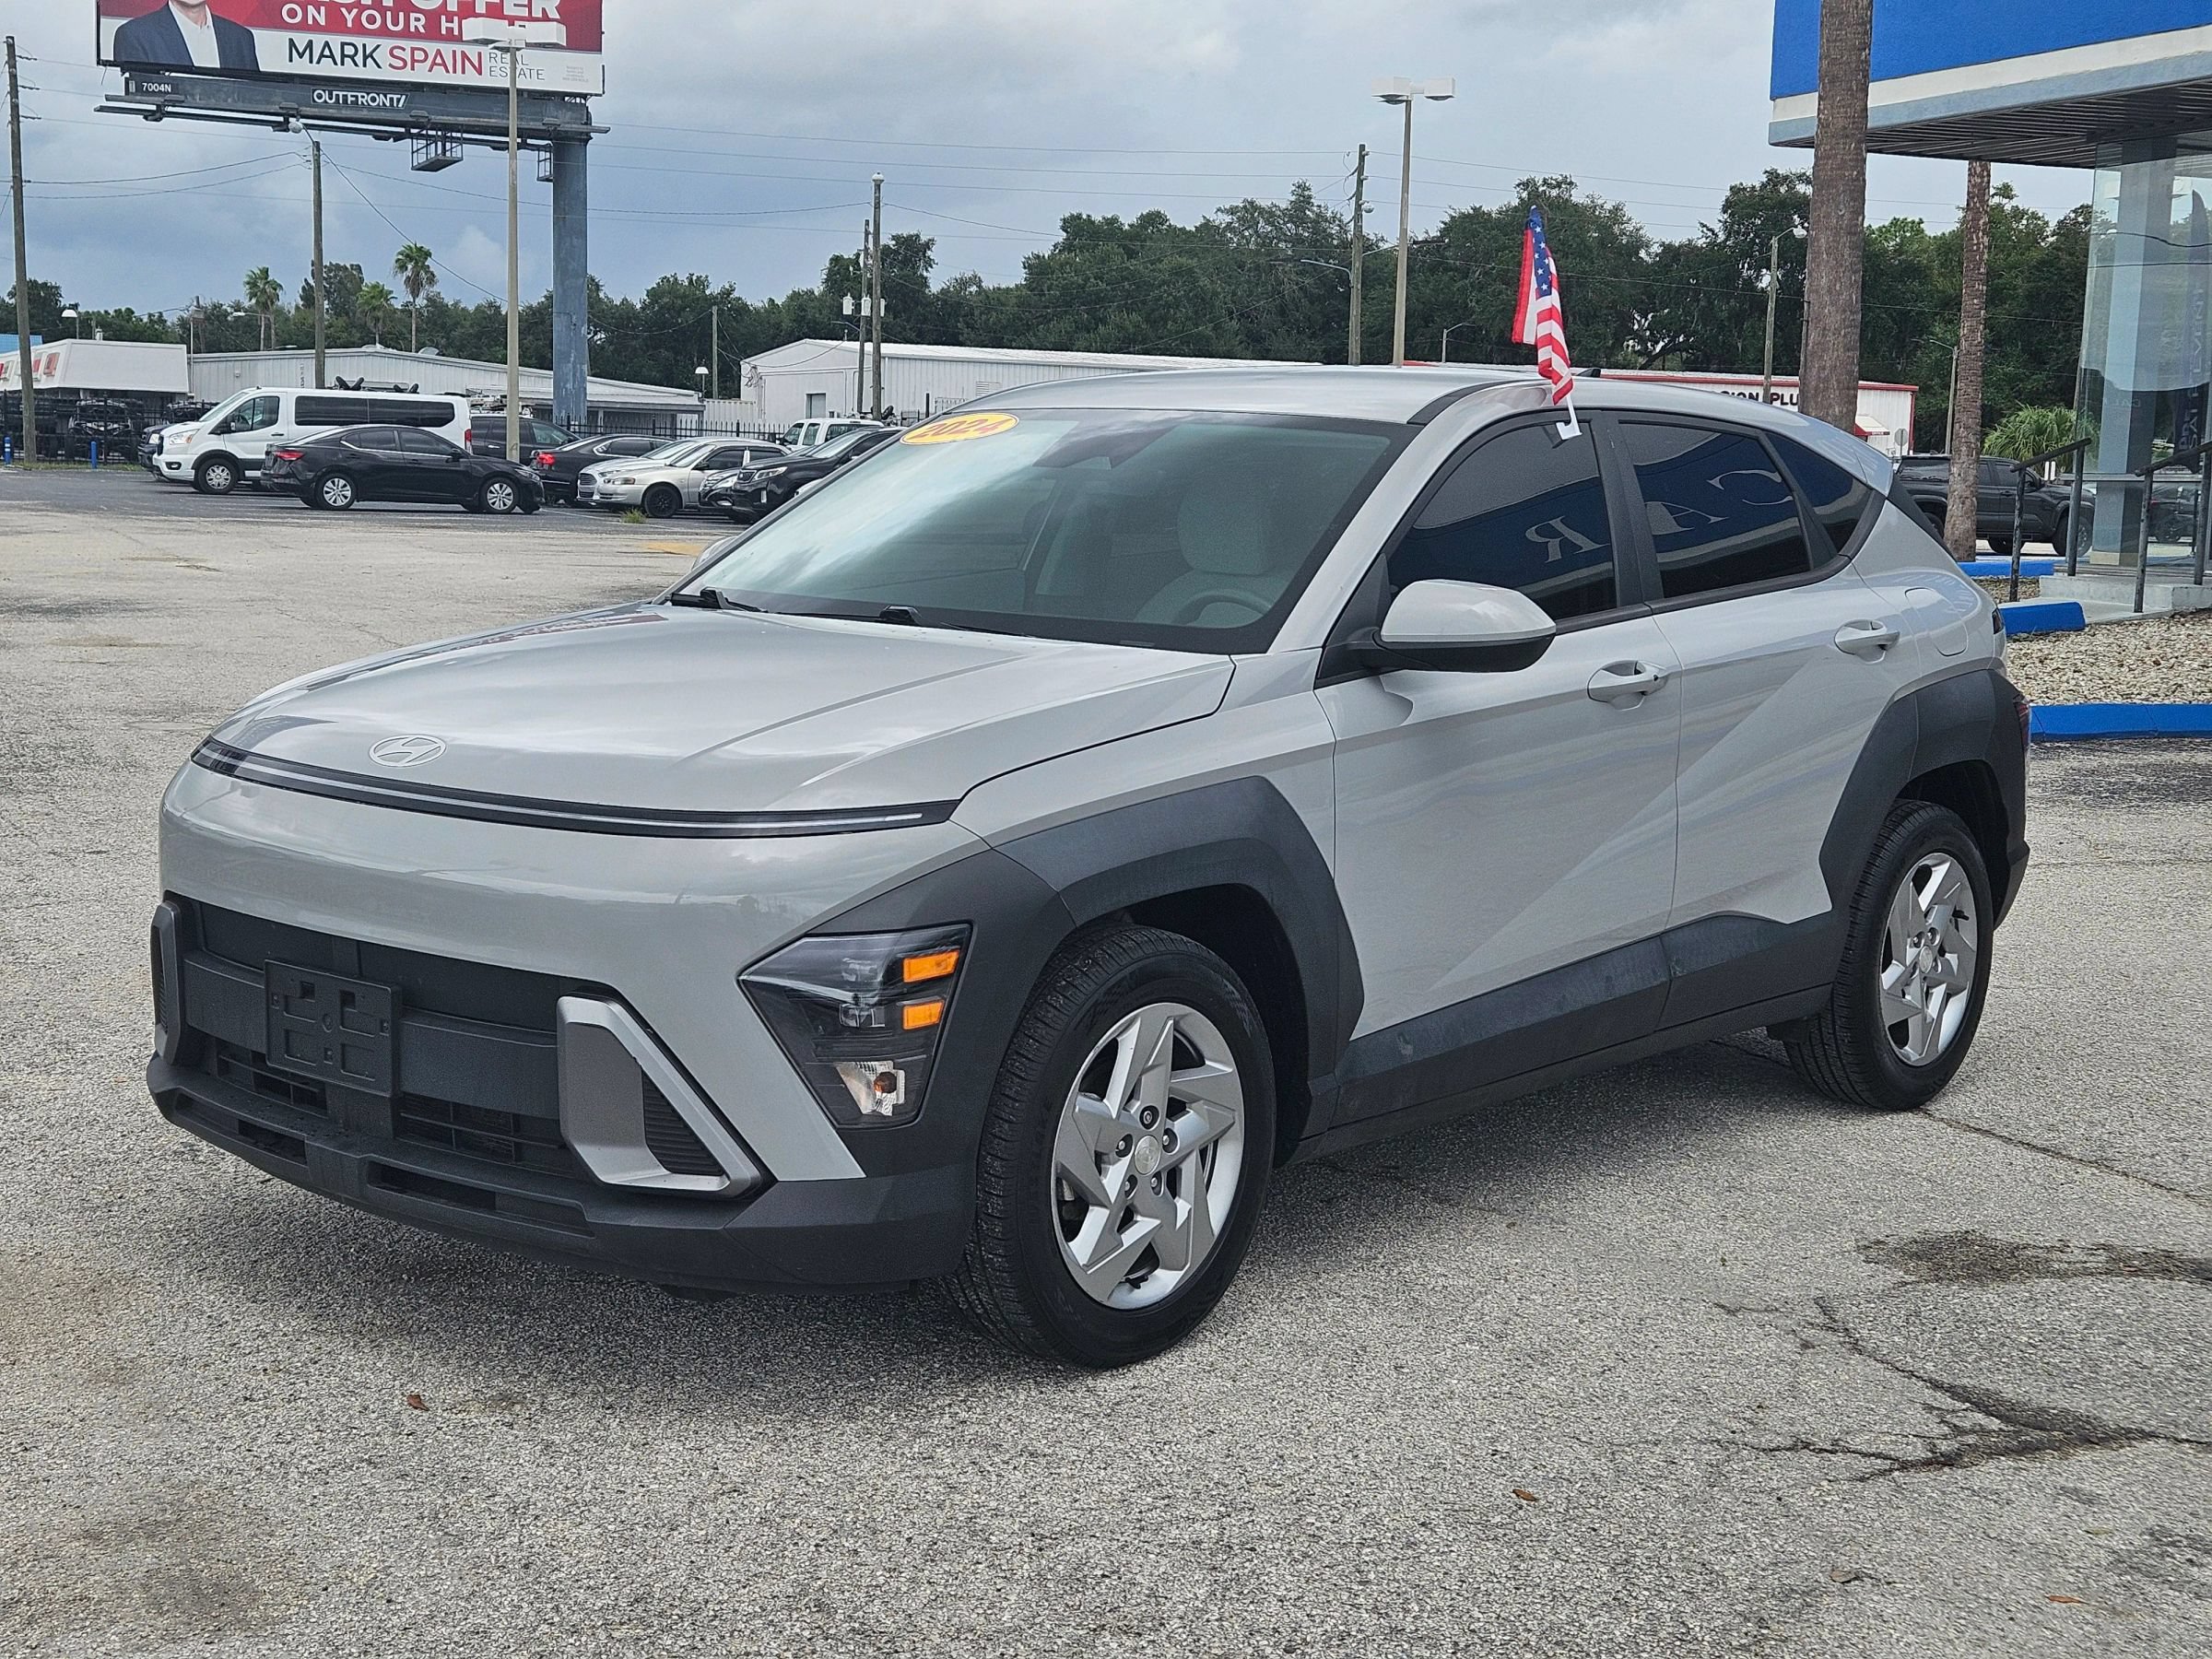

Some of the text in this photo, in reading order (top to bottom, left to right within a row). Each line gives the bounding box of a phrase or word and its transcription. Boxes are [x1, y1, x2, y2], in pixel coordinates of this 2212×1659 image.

[281, 4, 325, 26] ON
[340, 7, 426, 33] YOUR
[288, 38, 483, 76] MARK SPAIN
[488, 65, 546, 81] ESATE
[141, 82, 171, 92] 7004N
[1770, 392, 1799, 406] PLU
[905, 418, 1015, 440] 2024
